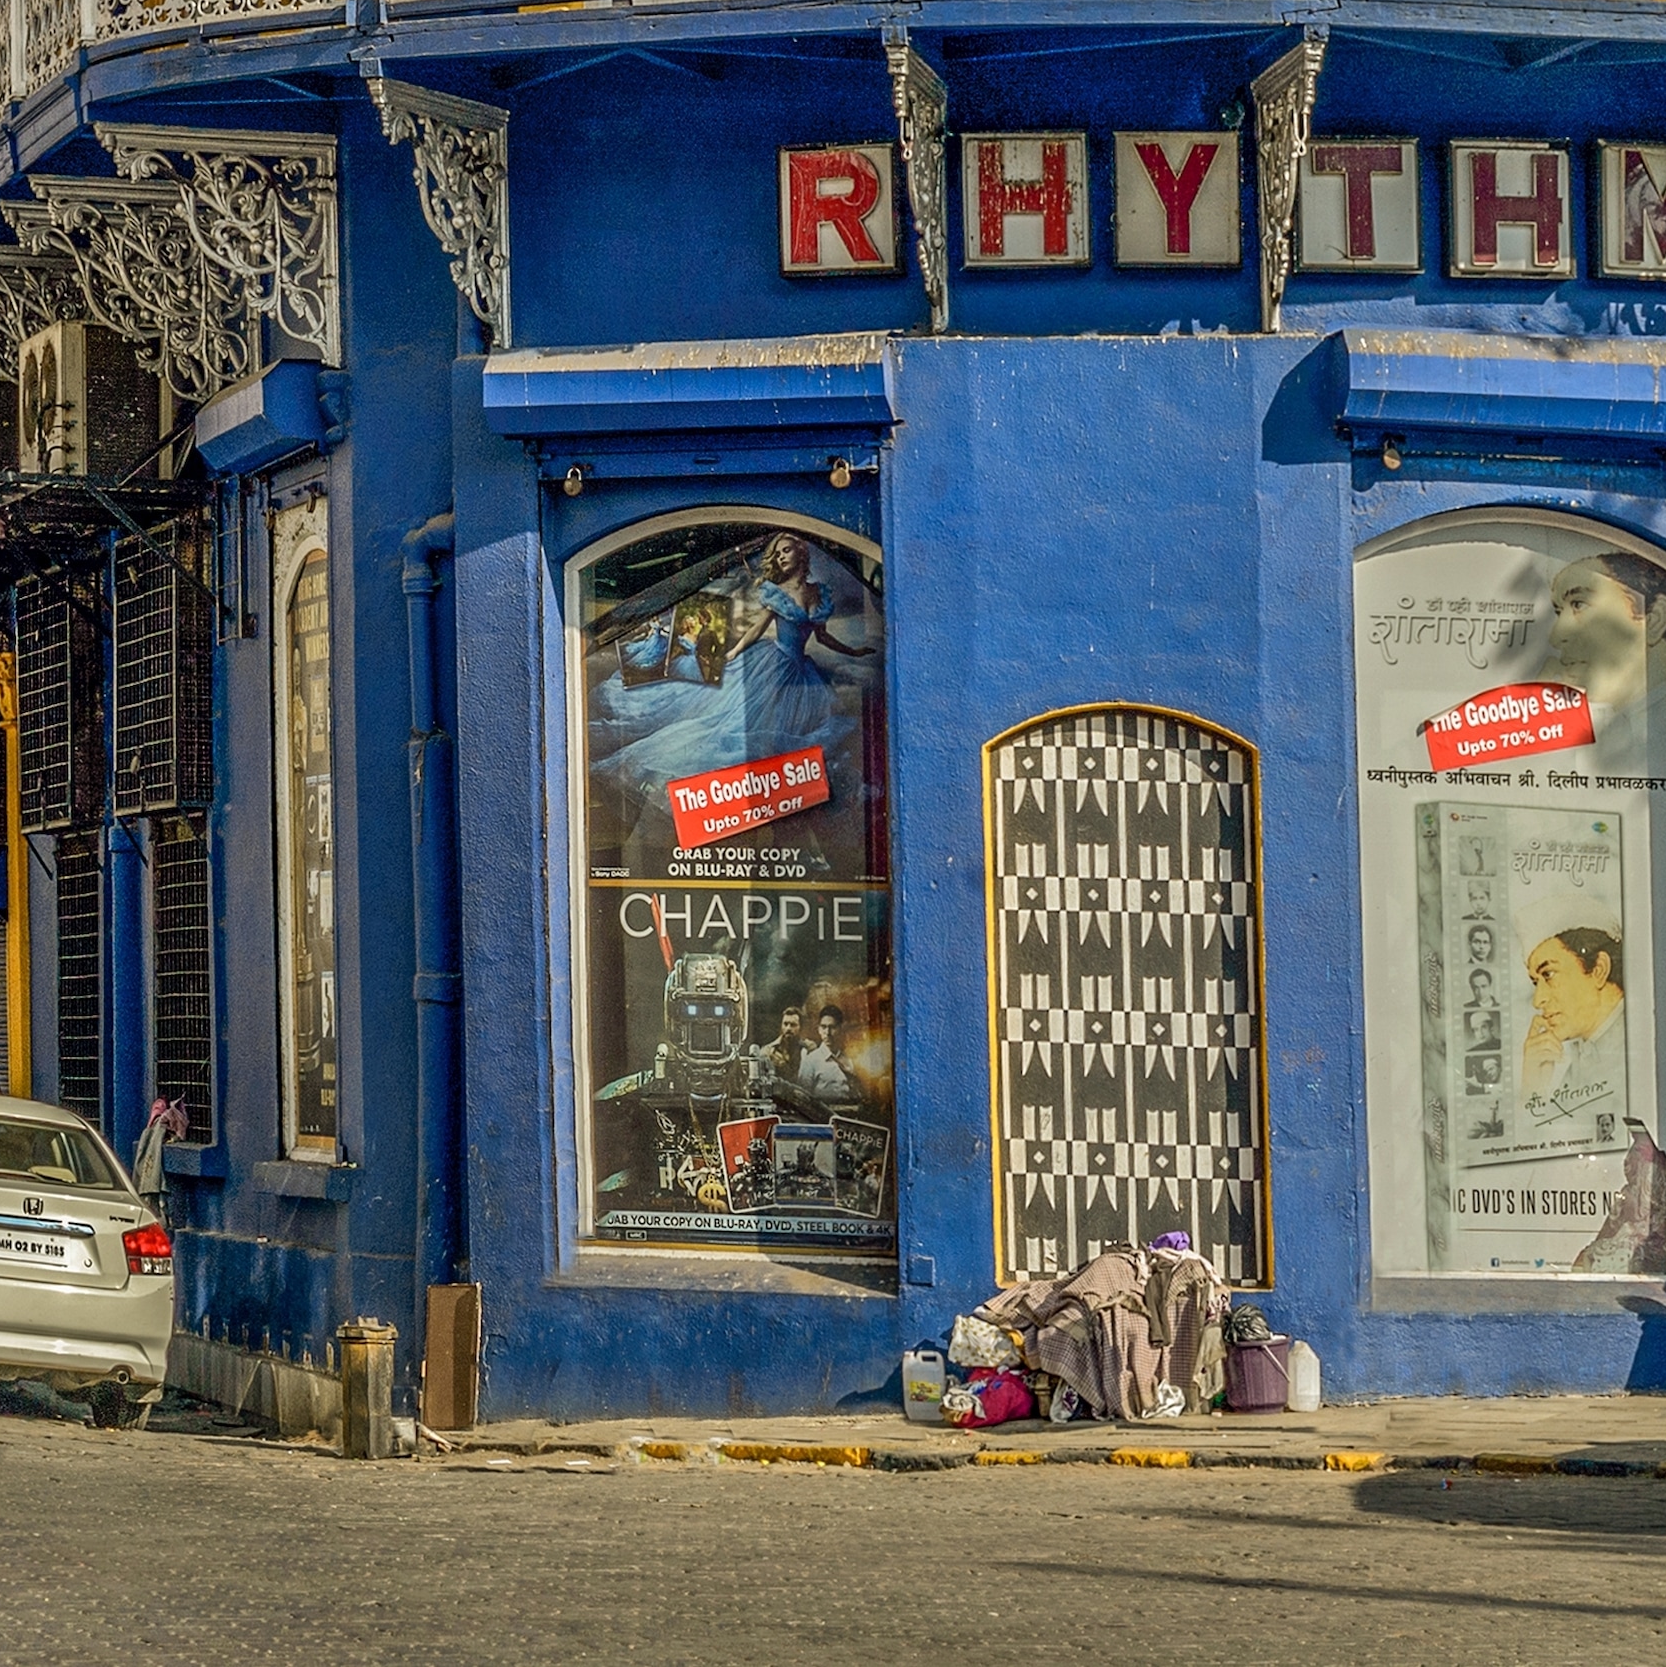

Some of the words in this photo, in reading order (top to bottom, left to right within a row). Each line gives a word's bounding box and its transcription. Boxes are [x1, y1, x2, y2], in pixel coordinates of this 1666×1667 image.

[1464, 694, 1539, 727] Goodbye
[1541, 687, 1582, 714] Sale
[1457, 739, 1496, 757] Upto
[1499, 729, 1535, 747] 70%
[1539, 724, 1563, 740] Off
[674, 788, 708, 812] The
[709, 771, 780, 805] Goodbye
[783, 758, 821, 787] Sale
[1445, 768, 1511, 786] अभिवाचन
[1548, 770, 1588, 789] दिलीप
[703, 815, 740, 833] Upto
[743, 804, 775, 824] 70%
[778, 796, 803, 813] Off
[672, 847, 712, 860] GRAB
[716, 848, 756, 860] YOUR
[760, 848, 801, 861] COPY
[668, 863, 691, 876] ON
[759, 865, 769, 877] &
[775, 865, 806, 878] DVD
[1472, 1189, 1515, 1214] DVD'S
[1521, 1190, 1536, 1214] IN
[1542, 1190, 1597, 1215] STORES
[631, 1215, 661, 1226] YOUR
[663, 1217, 692, 1227] COPY
[695, 1218, 712, 1228] ON
[714, 1218, 763, 1231] BLU-RAY,
[797, 1222, 829, 1232] STEEL
[833, 1223, 863, 1234] BOOK
[15, 1241, 28, 1252] 02
